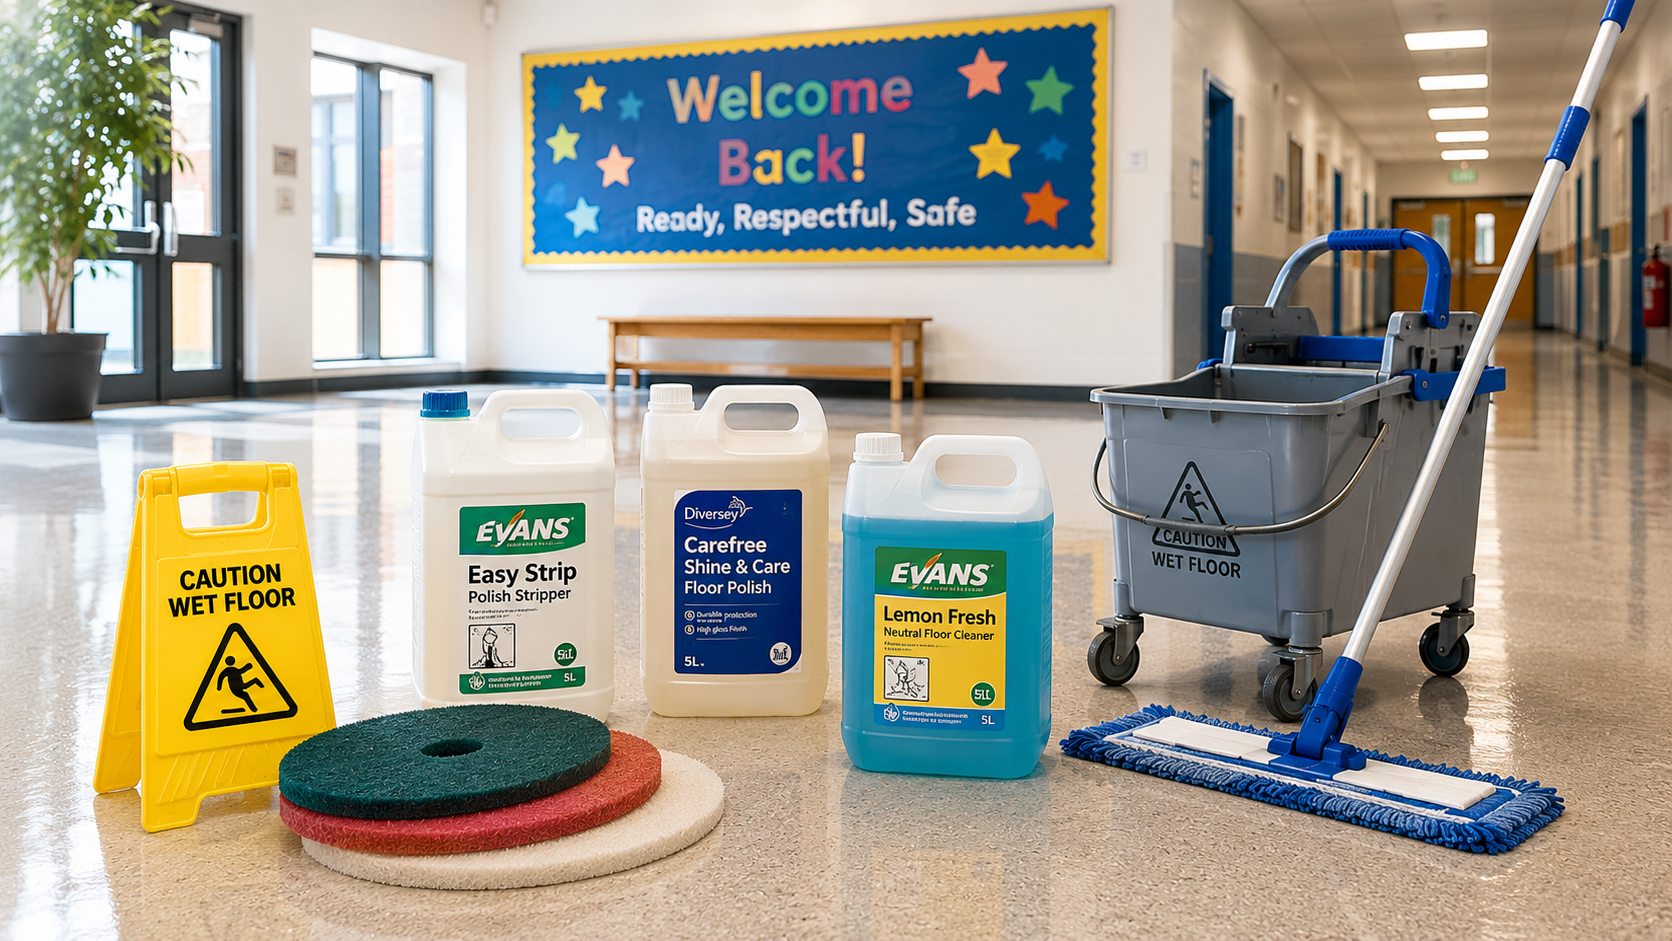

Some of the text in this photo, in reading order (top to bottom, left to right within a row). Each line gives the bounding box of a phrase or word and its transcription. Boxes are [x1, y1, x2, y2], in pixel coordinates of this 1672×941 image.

[667, 70, 914, 124] Welcome
[718, 132, 866, 187] Back!
[636, 196, 977, 238] Ready, Respectful, Safe
[684, 507, 739, 523] Diversey
[476, 517, 571, 548] EVANS
[684, 536, 767, 553] Carefree
[1163, 529, 1227, 549] CAUTION
[180, 563, 281, 591] CAUTION
[468, 561, 577, 588] Easy Strip
[684, 558, 791, 574] Shine & Care
[890, 561, 990, 590] EVANS
[1152, 551, 1241, 579] WET FLOOR
[468, 588, 571, 604] Polish Stripper
[684, 579, 772, 595] Floor Polish
[168, 587, 296, 618] WET FLOOR
[884, 605, 996, 625] Lemon Fresh
[883, 627, 994, 641] Neutral Floor Cleaner
